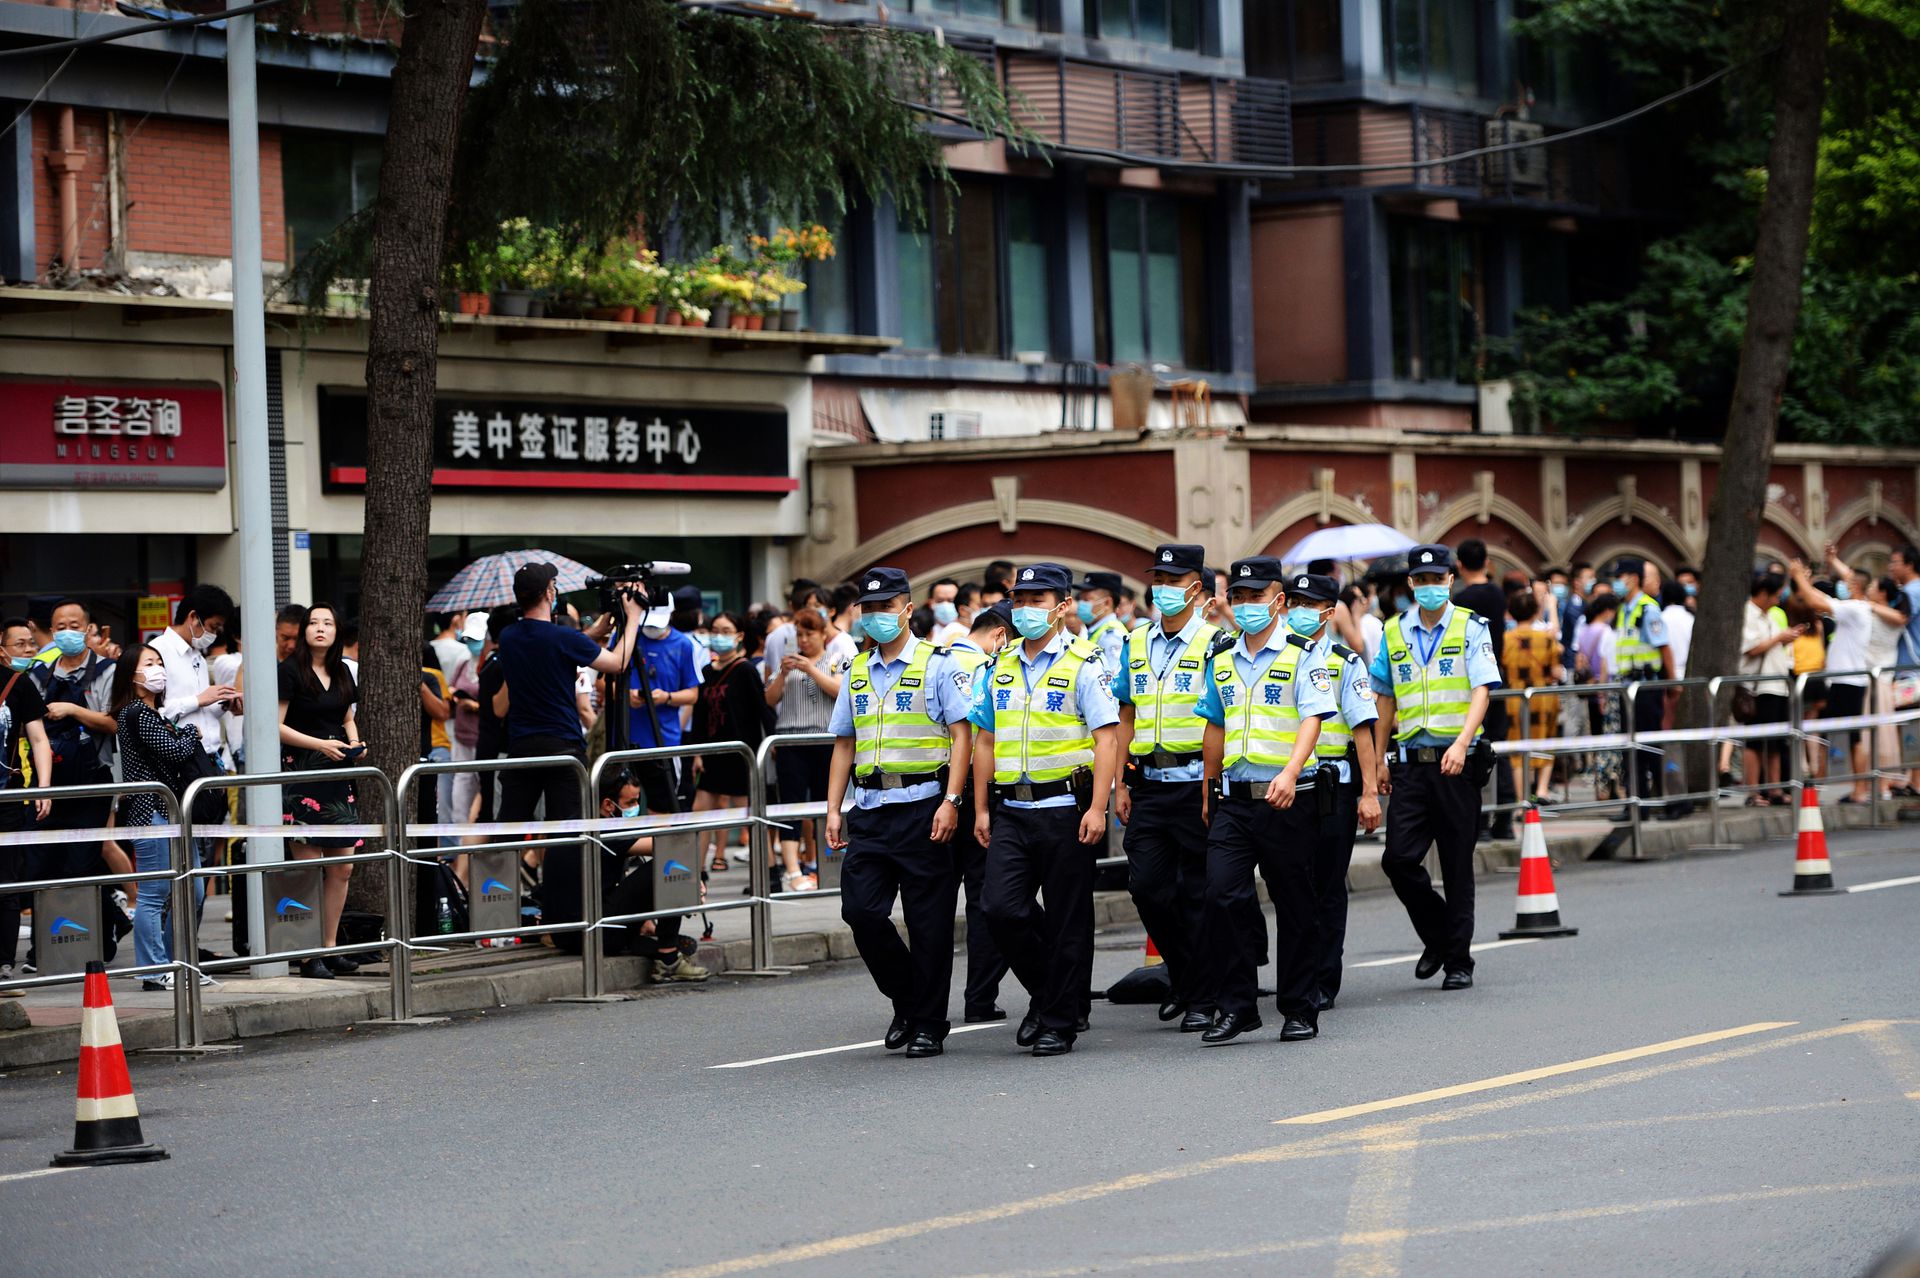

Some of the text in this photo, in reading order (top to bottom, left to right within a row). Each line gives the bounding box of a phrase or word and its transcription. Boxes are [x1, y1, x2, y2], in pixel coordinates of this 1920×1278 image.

[54, 395, 181, 437] 名圣咨询
[57, 443, 175, 460] MINGSUN
[452, 411, 701, 465] 美中签证服务中心
